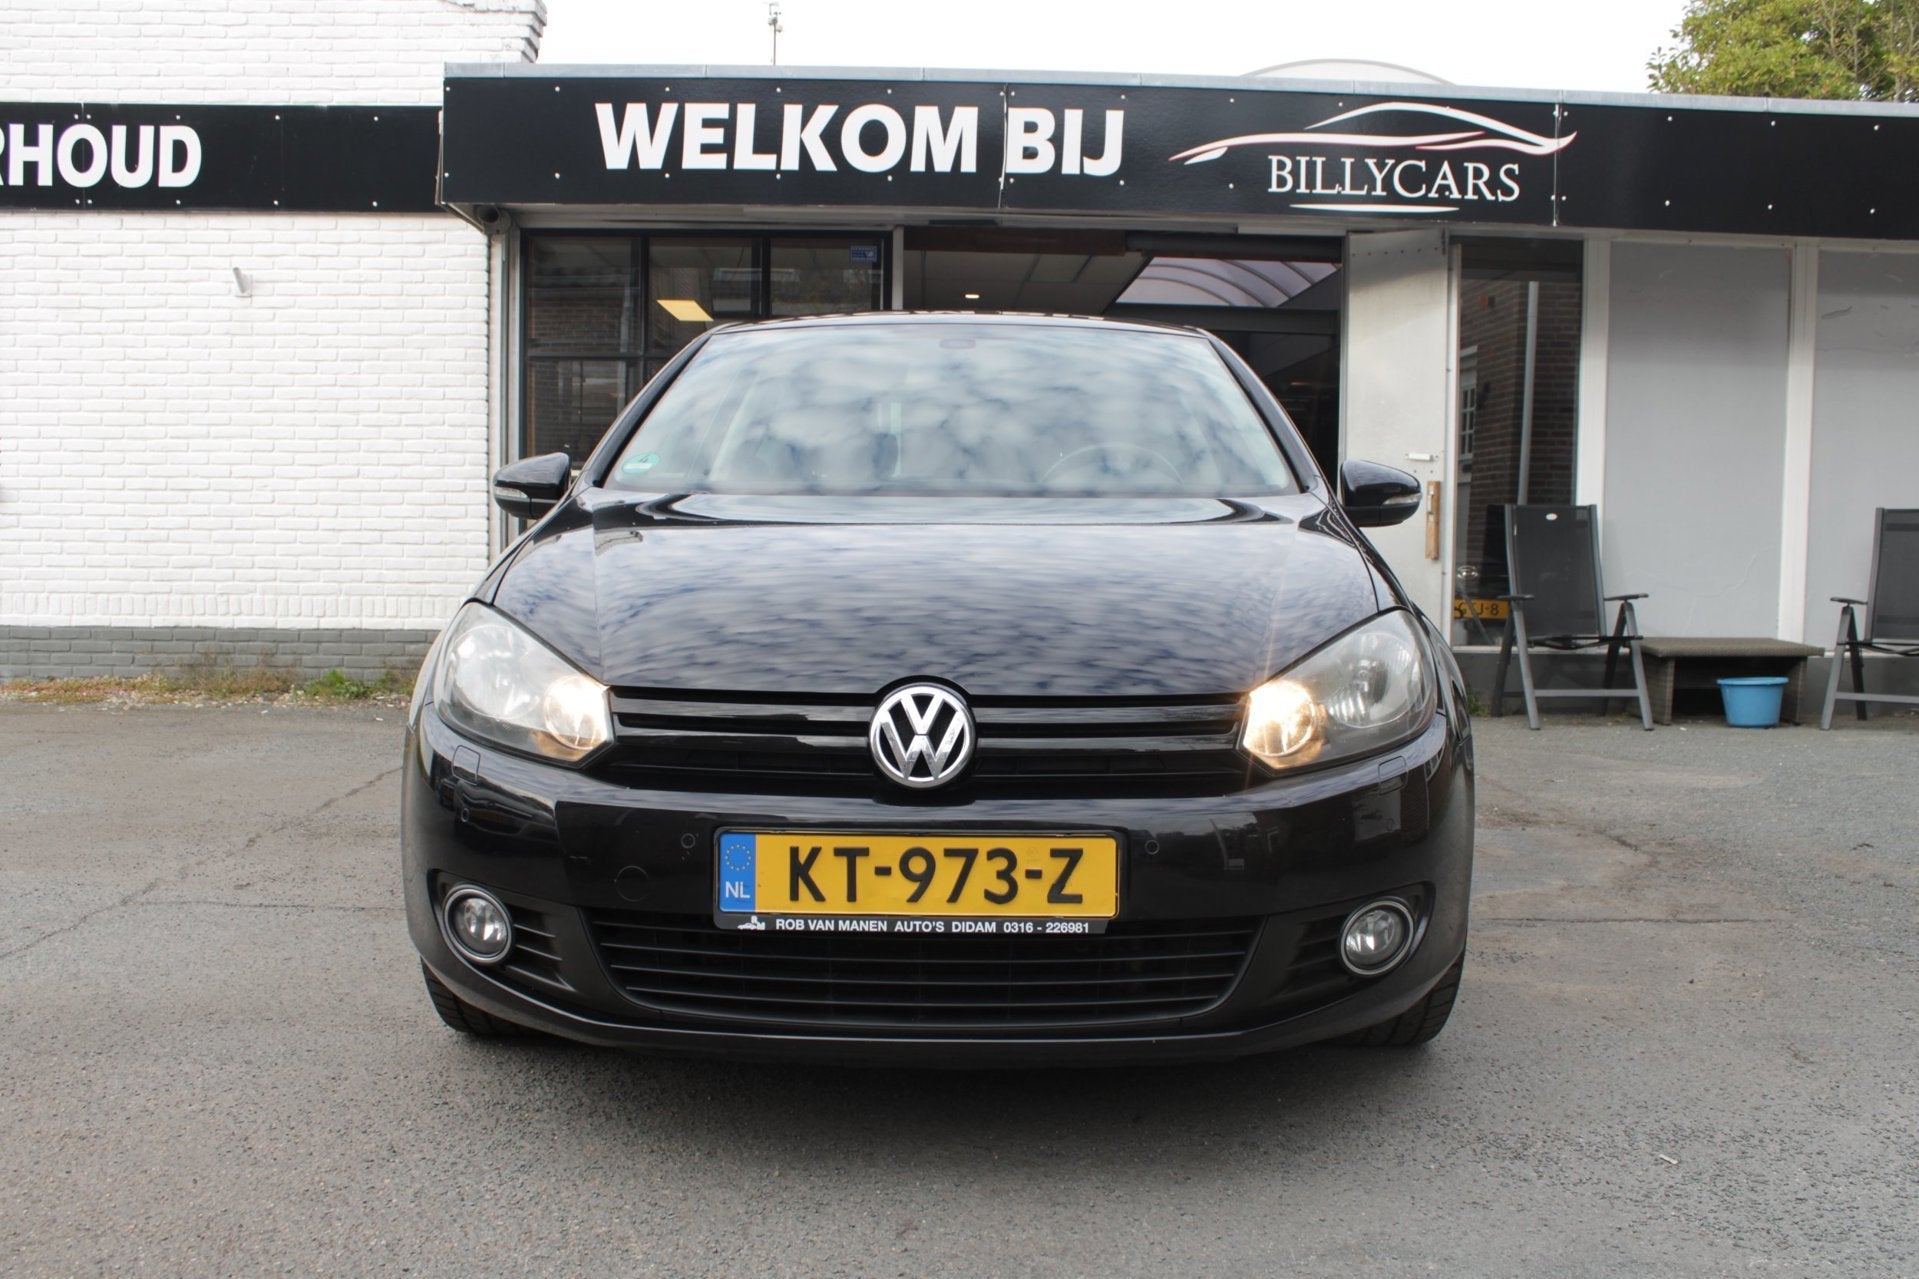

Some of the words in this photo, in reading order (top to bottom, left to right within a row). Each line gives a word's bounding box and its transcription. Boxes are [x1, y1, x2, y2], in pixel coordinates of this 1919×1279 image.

[0, 123, 202, 188] HOUD
[594, 102, 979, 174] WELKOM
[1005, 107, 1125, 177] BIJ
[1267, 154, 1521, 203] BILLYCARS
[725, 881, 750, 899] NL
[789, 846, 1083, 905] KT-973-Z
[775, 918, 805, 931] ROB
[808, 919, 835, 932] VAN
[838, 920, 888, 933] MANEN
[894, 920, 945, 933] AUTO'S
[952, 921, 996, 933] DIDAM
[1003, 922, 1034, 934] 0316
[1045, 922, 1089, 934] 226981
